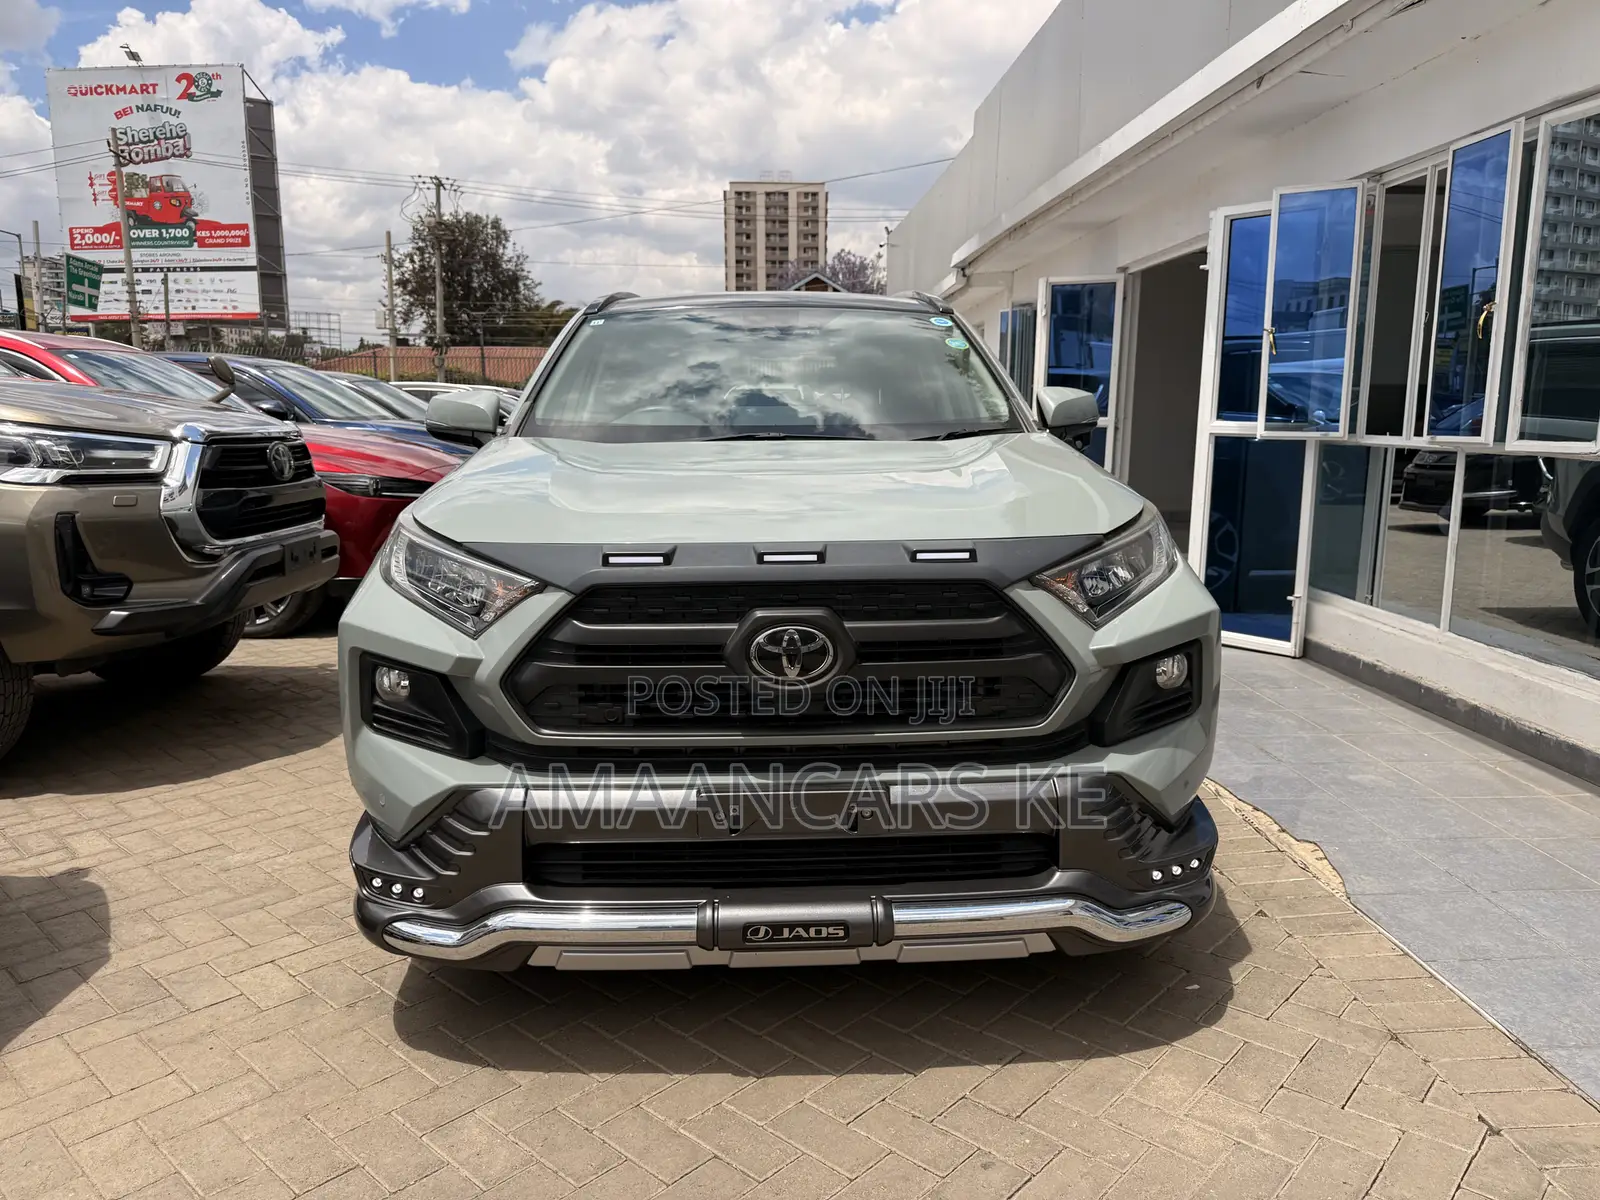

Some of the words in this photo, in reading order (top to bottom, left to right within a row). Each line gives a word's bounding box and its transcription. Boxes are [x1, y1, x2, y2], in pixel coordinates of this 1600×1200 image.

[67, 83, 159, 97] QUICKMART
[114, 106, 134, 120] BEI
[135, 104, 181, 119] NAFUU!
[116, 121, 188, 146] Sherehe
[73, 231, 120, 246] 2,000/-
[130, 229, 159, 238] OVER
[161, 228, 190, 239] 1,700
[773, 926, 845, 938] JAOS
